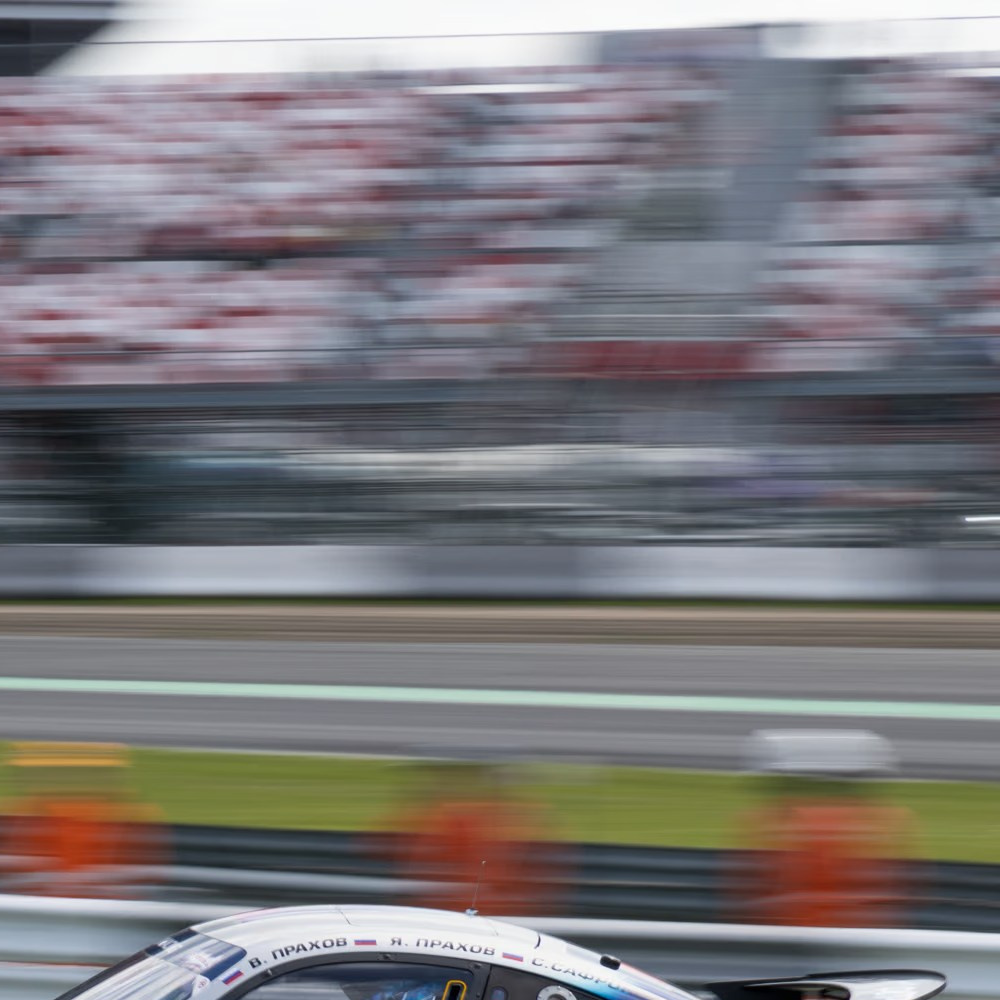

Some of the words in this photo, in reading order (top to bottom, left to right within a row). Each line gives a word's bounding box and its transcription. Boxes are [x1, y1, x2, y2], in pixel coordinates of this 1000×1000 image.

[248, 958, 268, 969] В.
[271, 937, 348, 960] ПРАХОВ
[390, 937, 409, 947] Я.
[415, 937, 496, 957] ПРАХОВ
